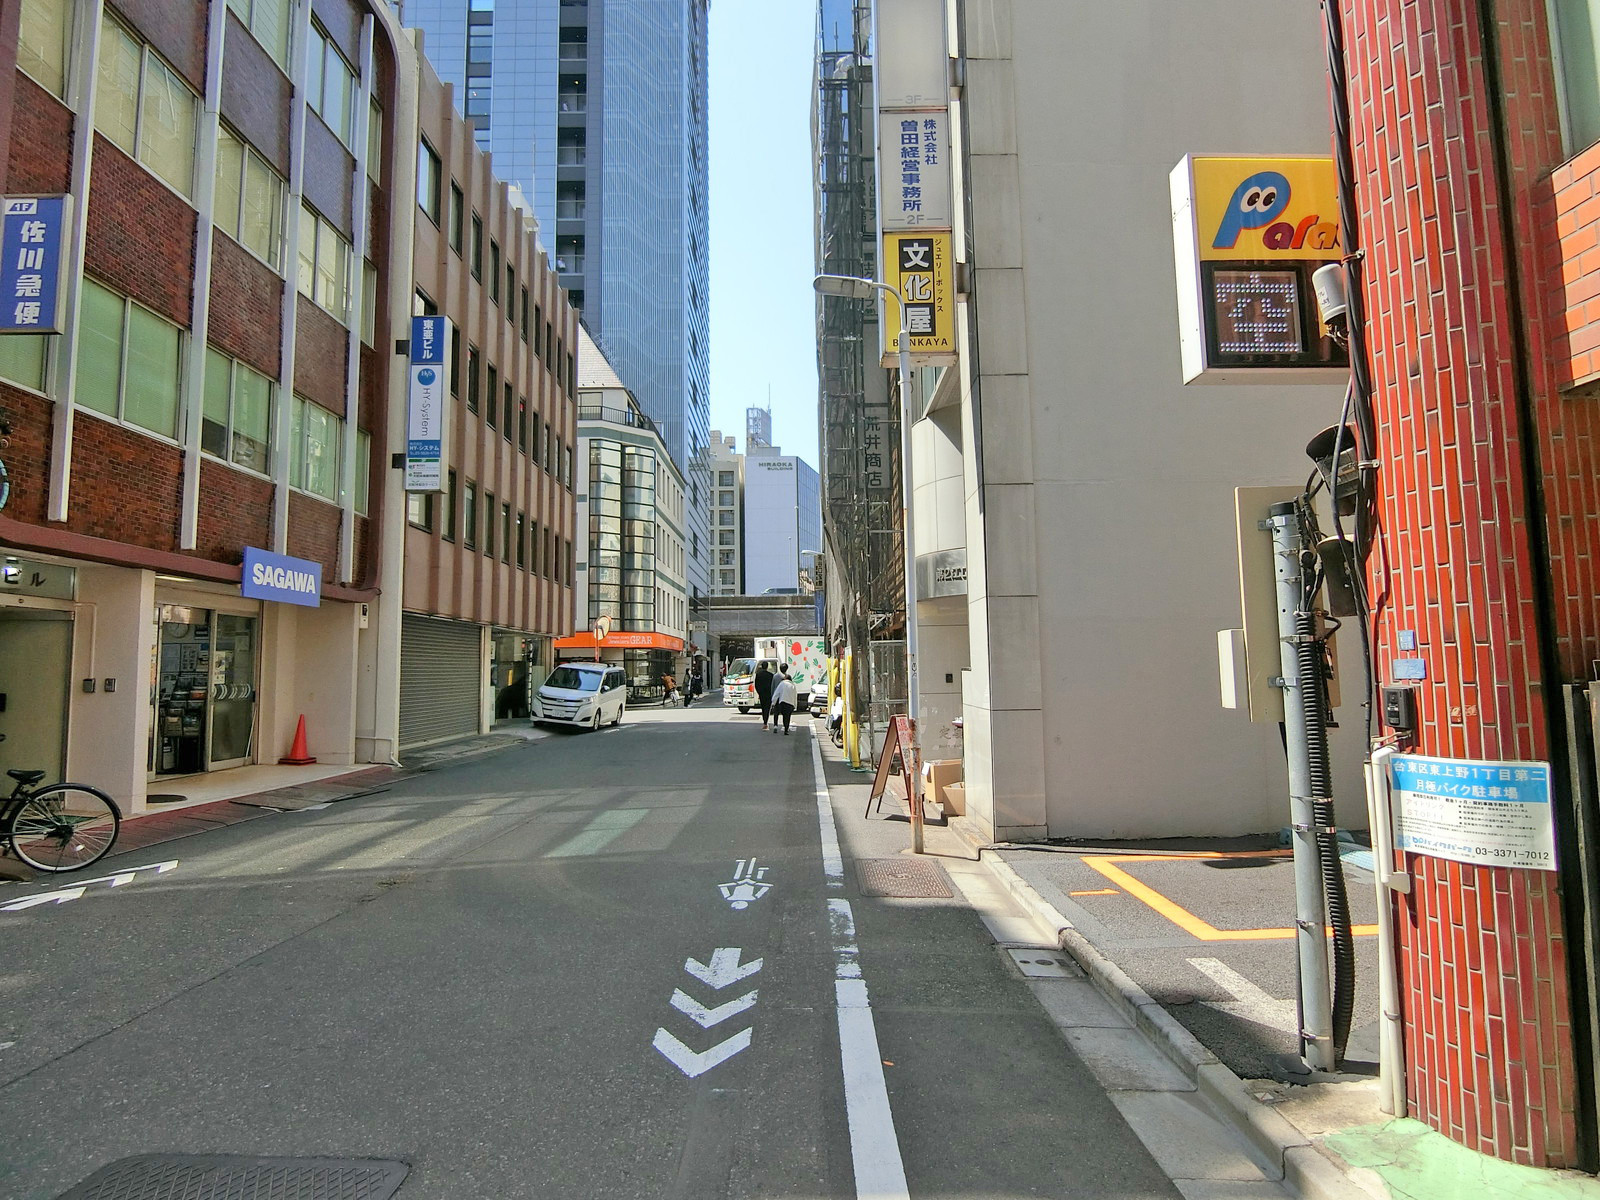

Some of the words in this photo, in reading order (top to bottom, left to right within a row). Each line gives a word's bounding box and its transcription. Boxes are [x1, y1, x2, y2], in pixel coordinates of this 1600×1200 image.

[904, 95, 922, 104] 3F
[923, 118, 938, 165] 株式会社
[900, 119, 922, 212] 曽田経営事務所
[14, 203, 30, 212] 1F
[906, 214, 925, 225] 2F
[14, 221, 47, 325] 佐川急便
[902, 242, 932, 334] 文化屋
[935, 238, 944, 313] ジュエリーボックス
[1215, 273, 1300, 352] 空
[422, 319, 434, 359] 東亜ビル
[892, 338, 948, 347] BNKAYA
[420, 387, 431, 437] HY-System
[252, 562, 316, 595] SAGAWA
[630, 635, 653, 645] GEAR
[1393, 761, 1546, 782] 台東区東上野1丁目第二
[1415, 778, 1518, 800] 月極バイク駐車場
[1475, 847, 1550, 861] 03-3371-7012
